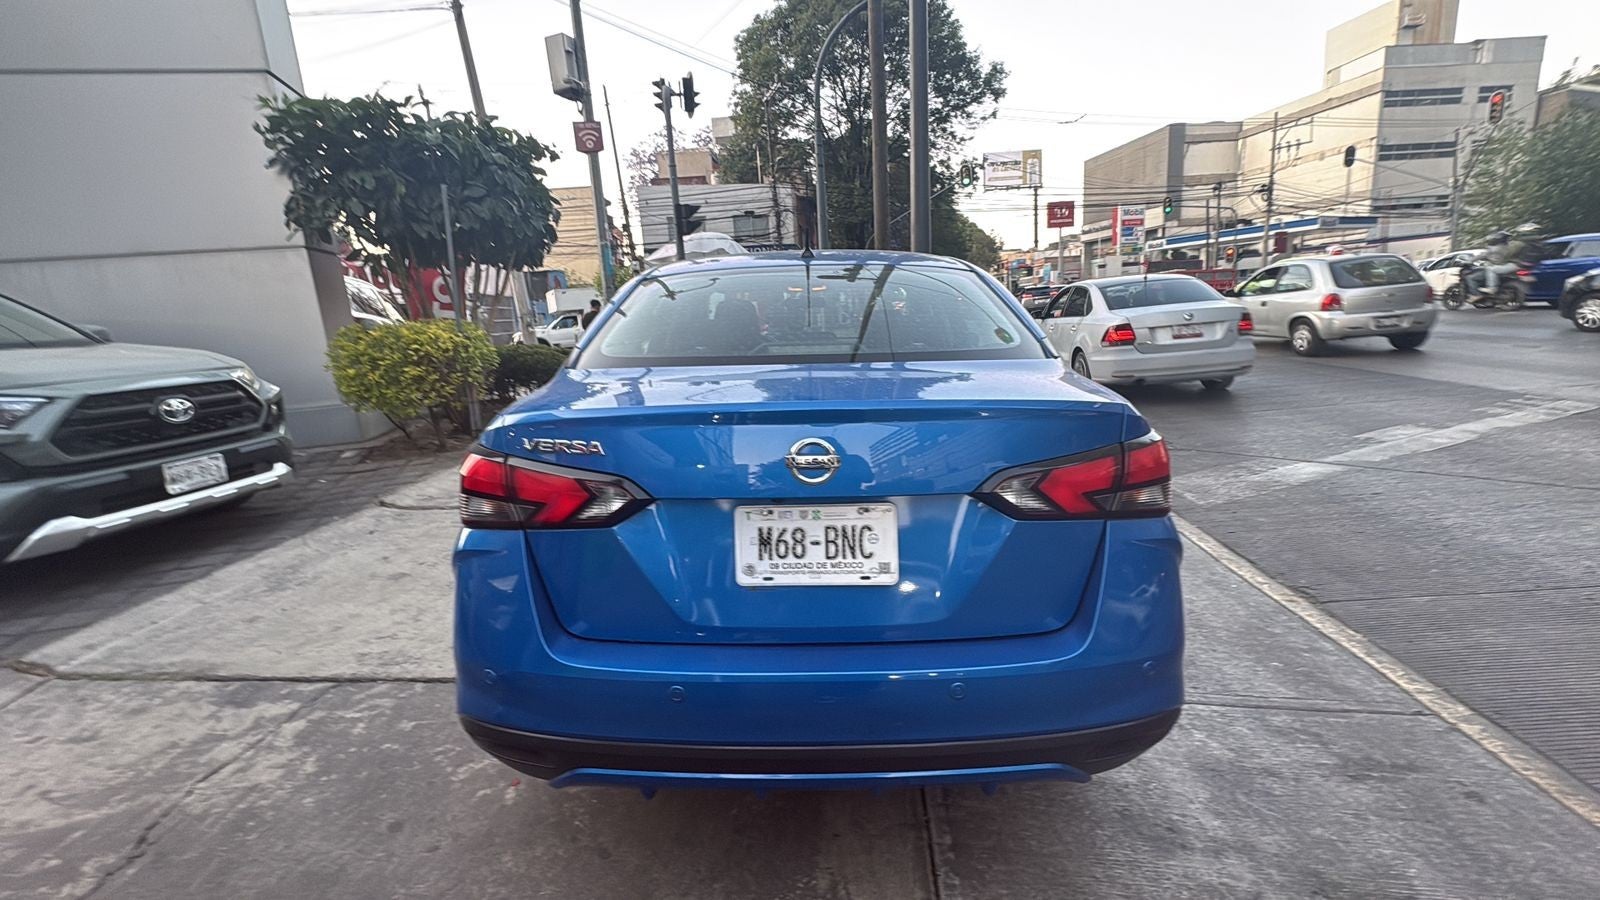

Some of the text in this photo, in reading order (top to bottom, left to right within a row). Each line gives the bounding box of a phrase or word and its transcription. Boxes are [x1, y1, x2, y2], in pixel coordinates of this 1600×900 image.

[521, 437, 606, 456] VERSA
[785, 456, 841, 467] NISSAN
[758, 525, 874, 560] M68-BNC
[781, 562, 815, 570] CIUDAD
[829, 560, 865, 569] MÉXICO
